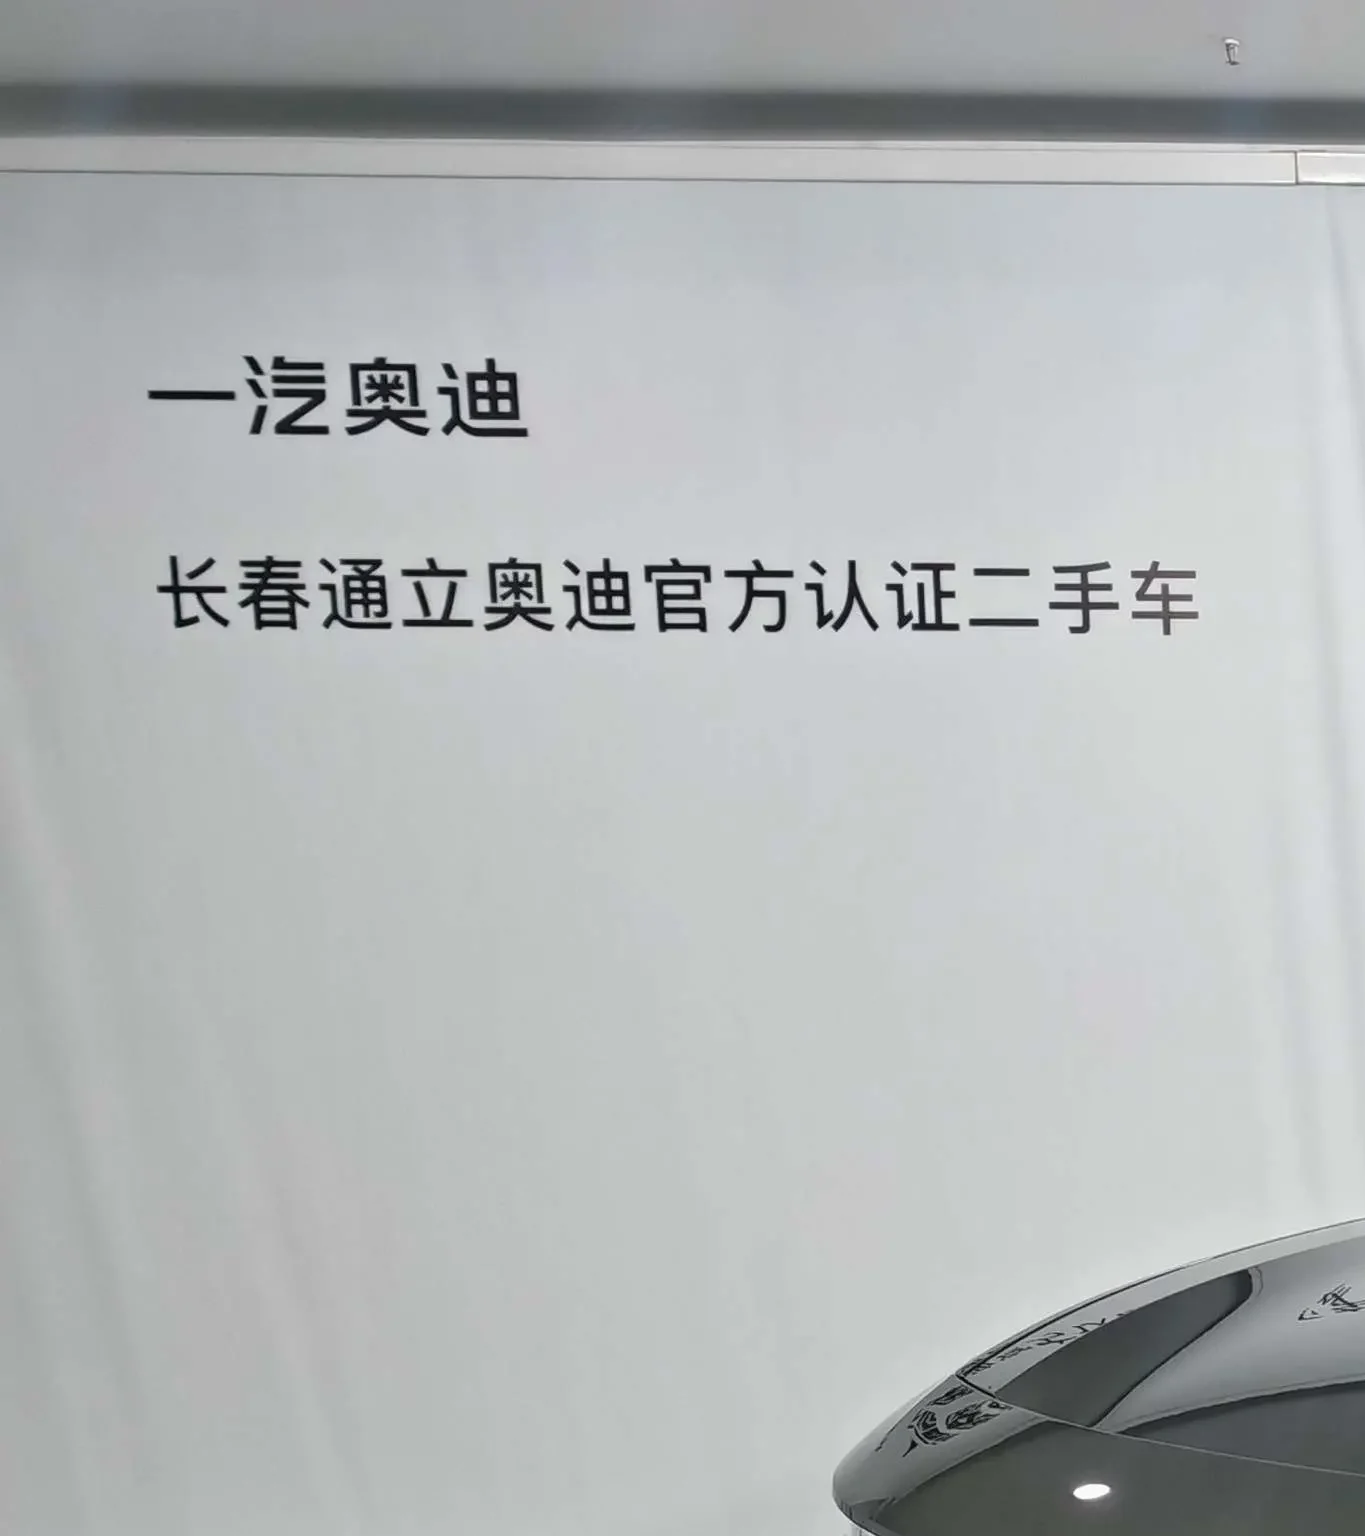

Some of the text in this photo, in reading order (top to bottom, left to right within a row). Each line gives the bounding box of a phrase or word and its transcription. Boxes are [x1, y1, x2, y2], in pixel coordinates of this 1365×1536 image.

[147, 355, 529, 438] 一汽奥迪
[156, 554, 1200, 635] 长春通立奥迪官方认证二手车
